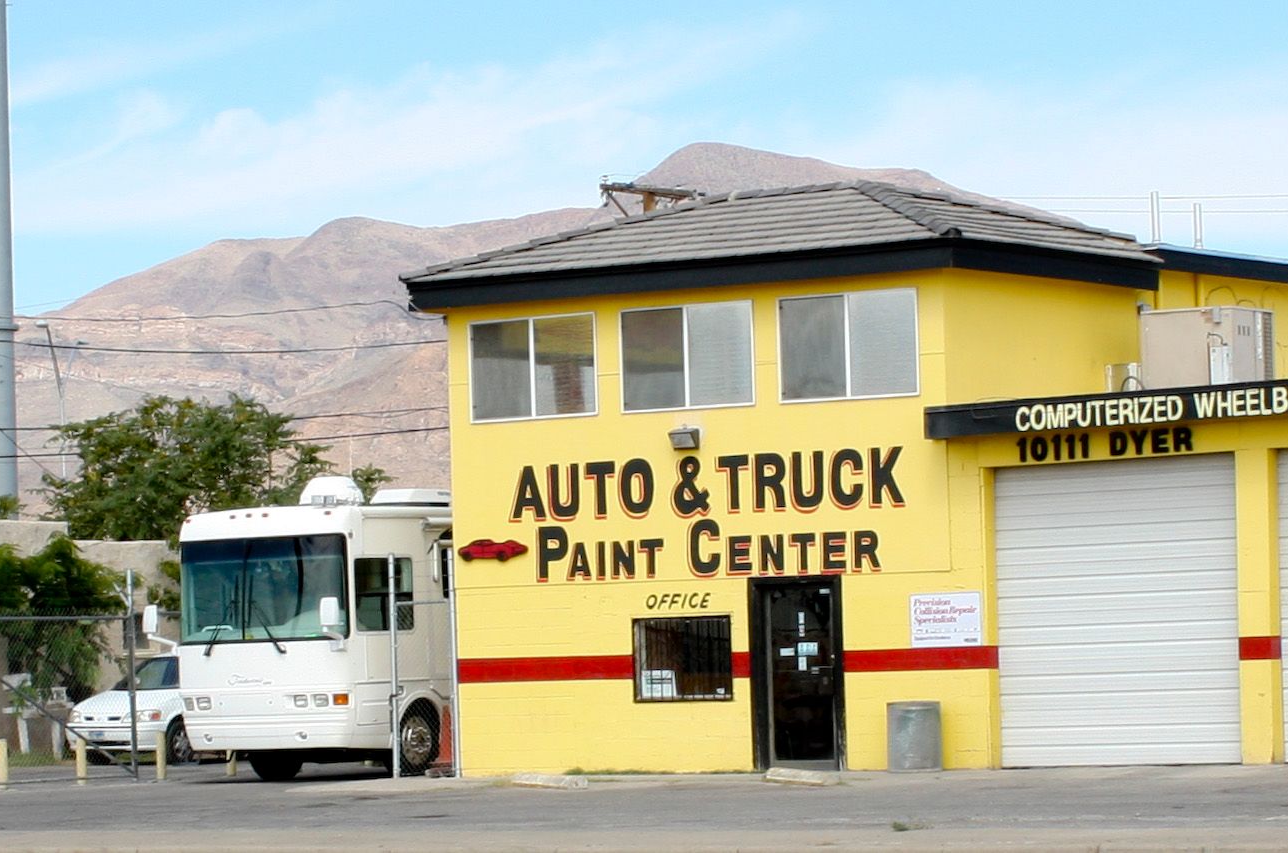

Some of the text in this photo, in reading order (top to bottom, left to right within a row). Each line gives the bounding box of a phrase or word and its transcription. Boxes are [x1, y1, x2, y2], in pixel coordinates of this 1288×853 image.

[1015, 395, 1183, 431] COMPUTERIZED
[1016, 432, 1090, 462] 10111
[1109, 427, 1193, 457] DYER
[509, 446, 906, 522] AUTO & TRUCK
[536, 518, 882, 583] PAINT CENTER
[646, 592, 711, 610] OFFICE
